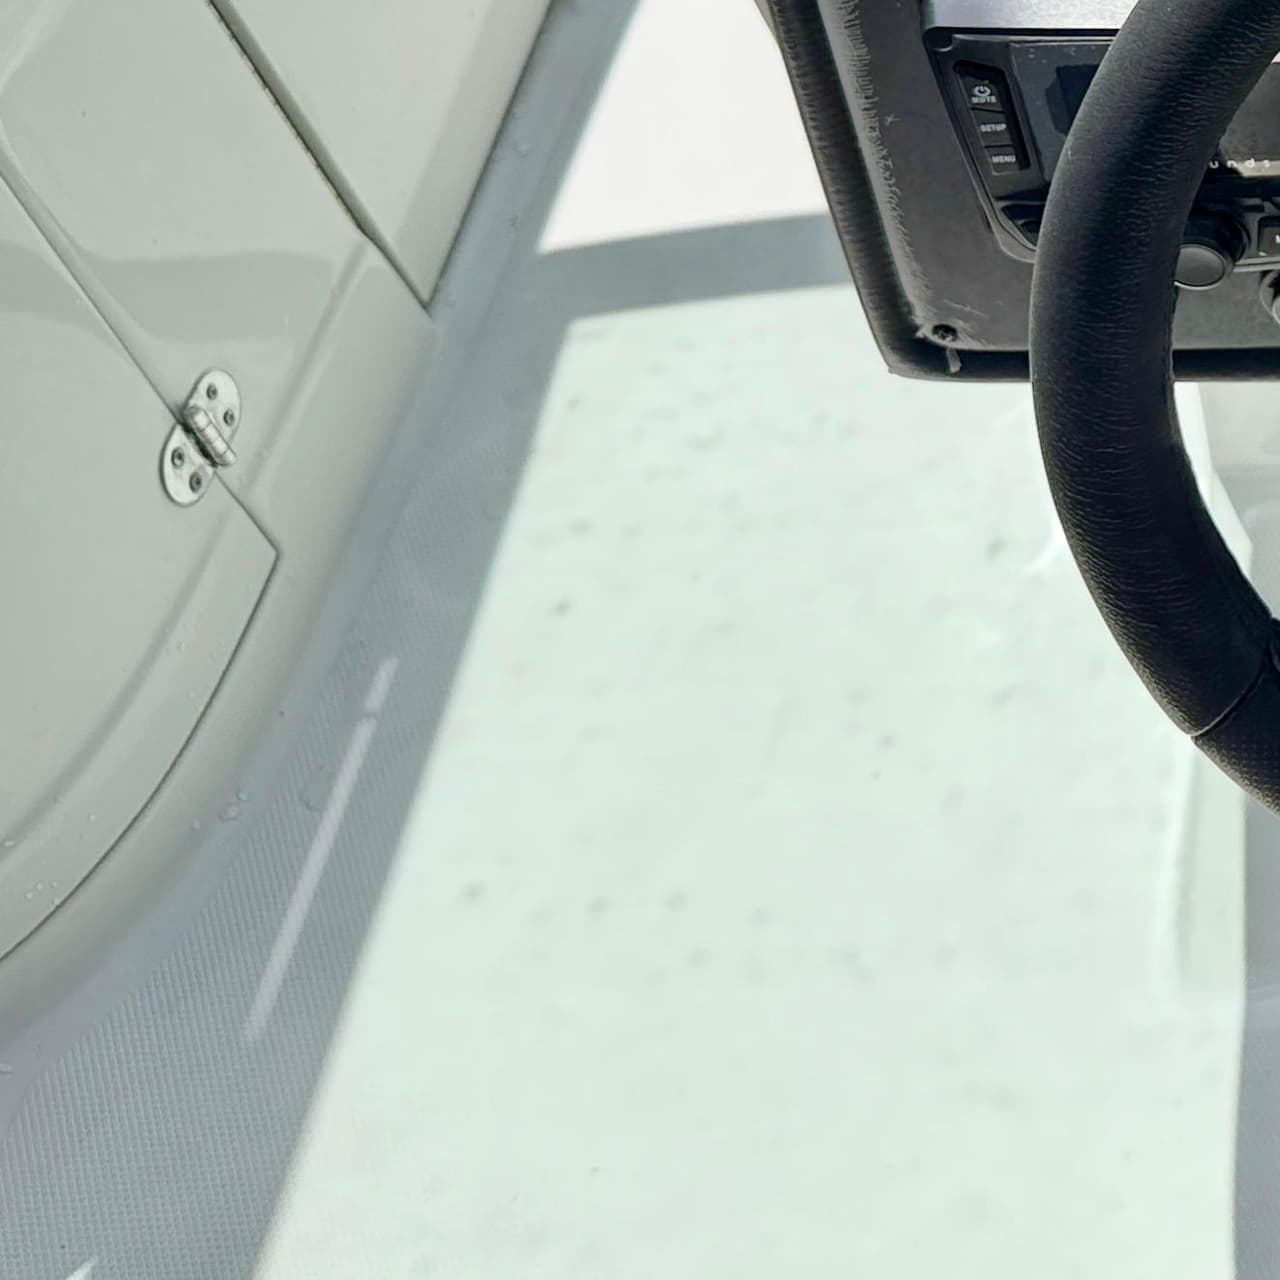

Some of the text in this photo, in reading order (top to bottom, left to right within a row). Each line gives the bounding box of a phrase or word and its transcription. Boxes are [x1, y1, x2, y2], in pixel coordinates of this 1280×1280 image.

[971, 96, 997, 104] MUTE
[979, 123, 1007, 133] SETUP
[991, 155, 1017, 164] MENU
